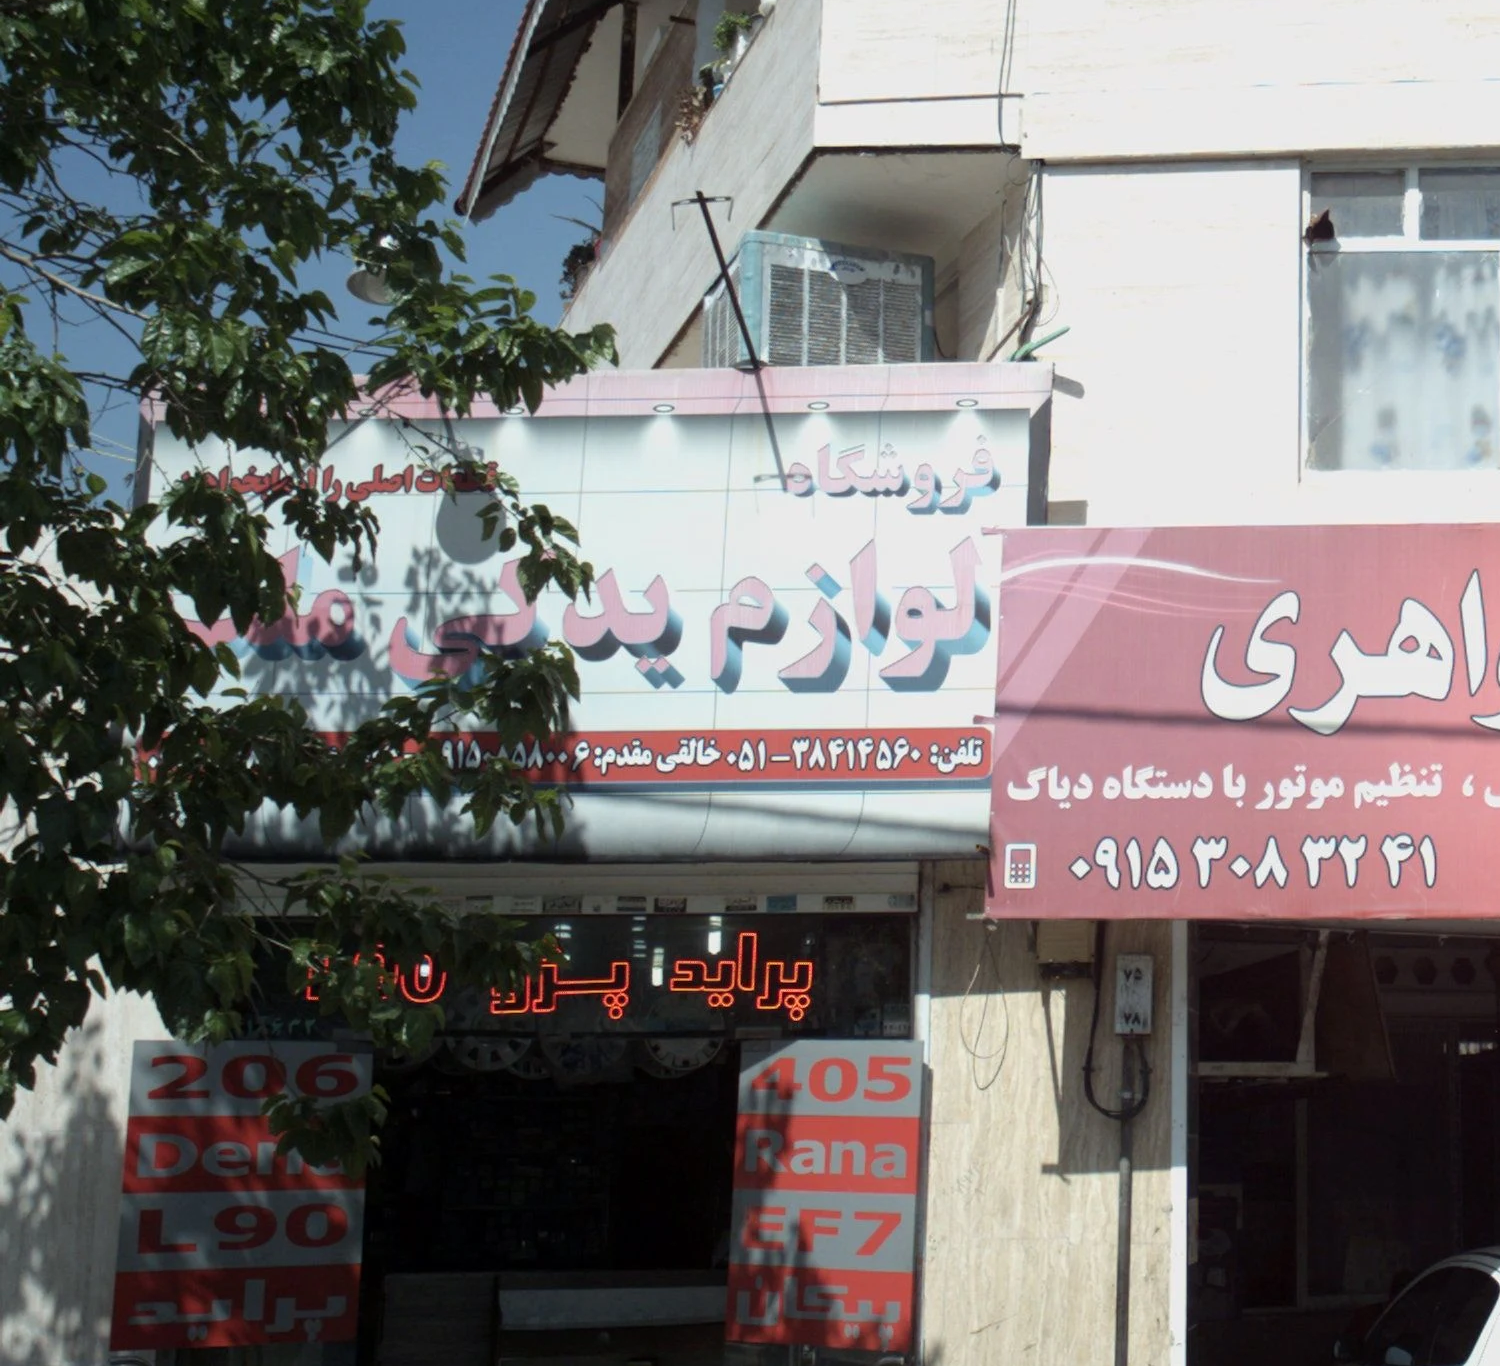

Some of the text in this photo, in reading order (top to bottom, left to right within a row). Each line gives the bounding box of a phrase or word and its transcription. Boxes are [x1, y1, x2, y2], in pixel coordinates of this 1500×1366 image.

[181, 465, 271, 501] بخواه
[322, 464, 341, 502] را
[345, 464, 415, 501] اصلی
[787, 435, 999, 512] فروشگاه
[389, 548, 682, 688] یدکی
[710, 536, 988, 691] لوازم
[594, 739, 652, 775] مقدم:
[656, 737, 722, 774] خالقی
[929, 737, 985, 773] تلفن:
[1006, 766, 1094, 809] دیاگ
[1102, 763, 1214, 800] دستگاه
[1222, 763, 1246, 807] با
[1255, 763, 1345, 810] موتور
[1353, 763, 1443, 809] تنظیم
[1069, 833, 1438, 890] ۰۹۱۵ ۳۰۸ ۳۲ ۴۱
[670, 933, 813, 1021] پراید
[148, 1054, 359, 1100] 206
[751, 1057, 912, 1103] 405
[744, 1129, 908, 1179] Rana
[742, 1207, 903, 1257] EF7
[128, 1279, 347, 1343] پراید
[736, 1276, 902, 1351] پیکان
